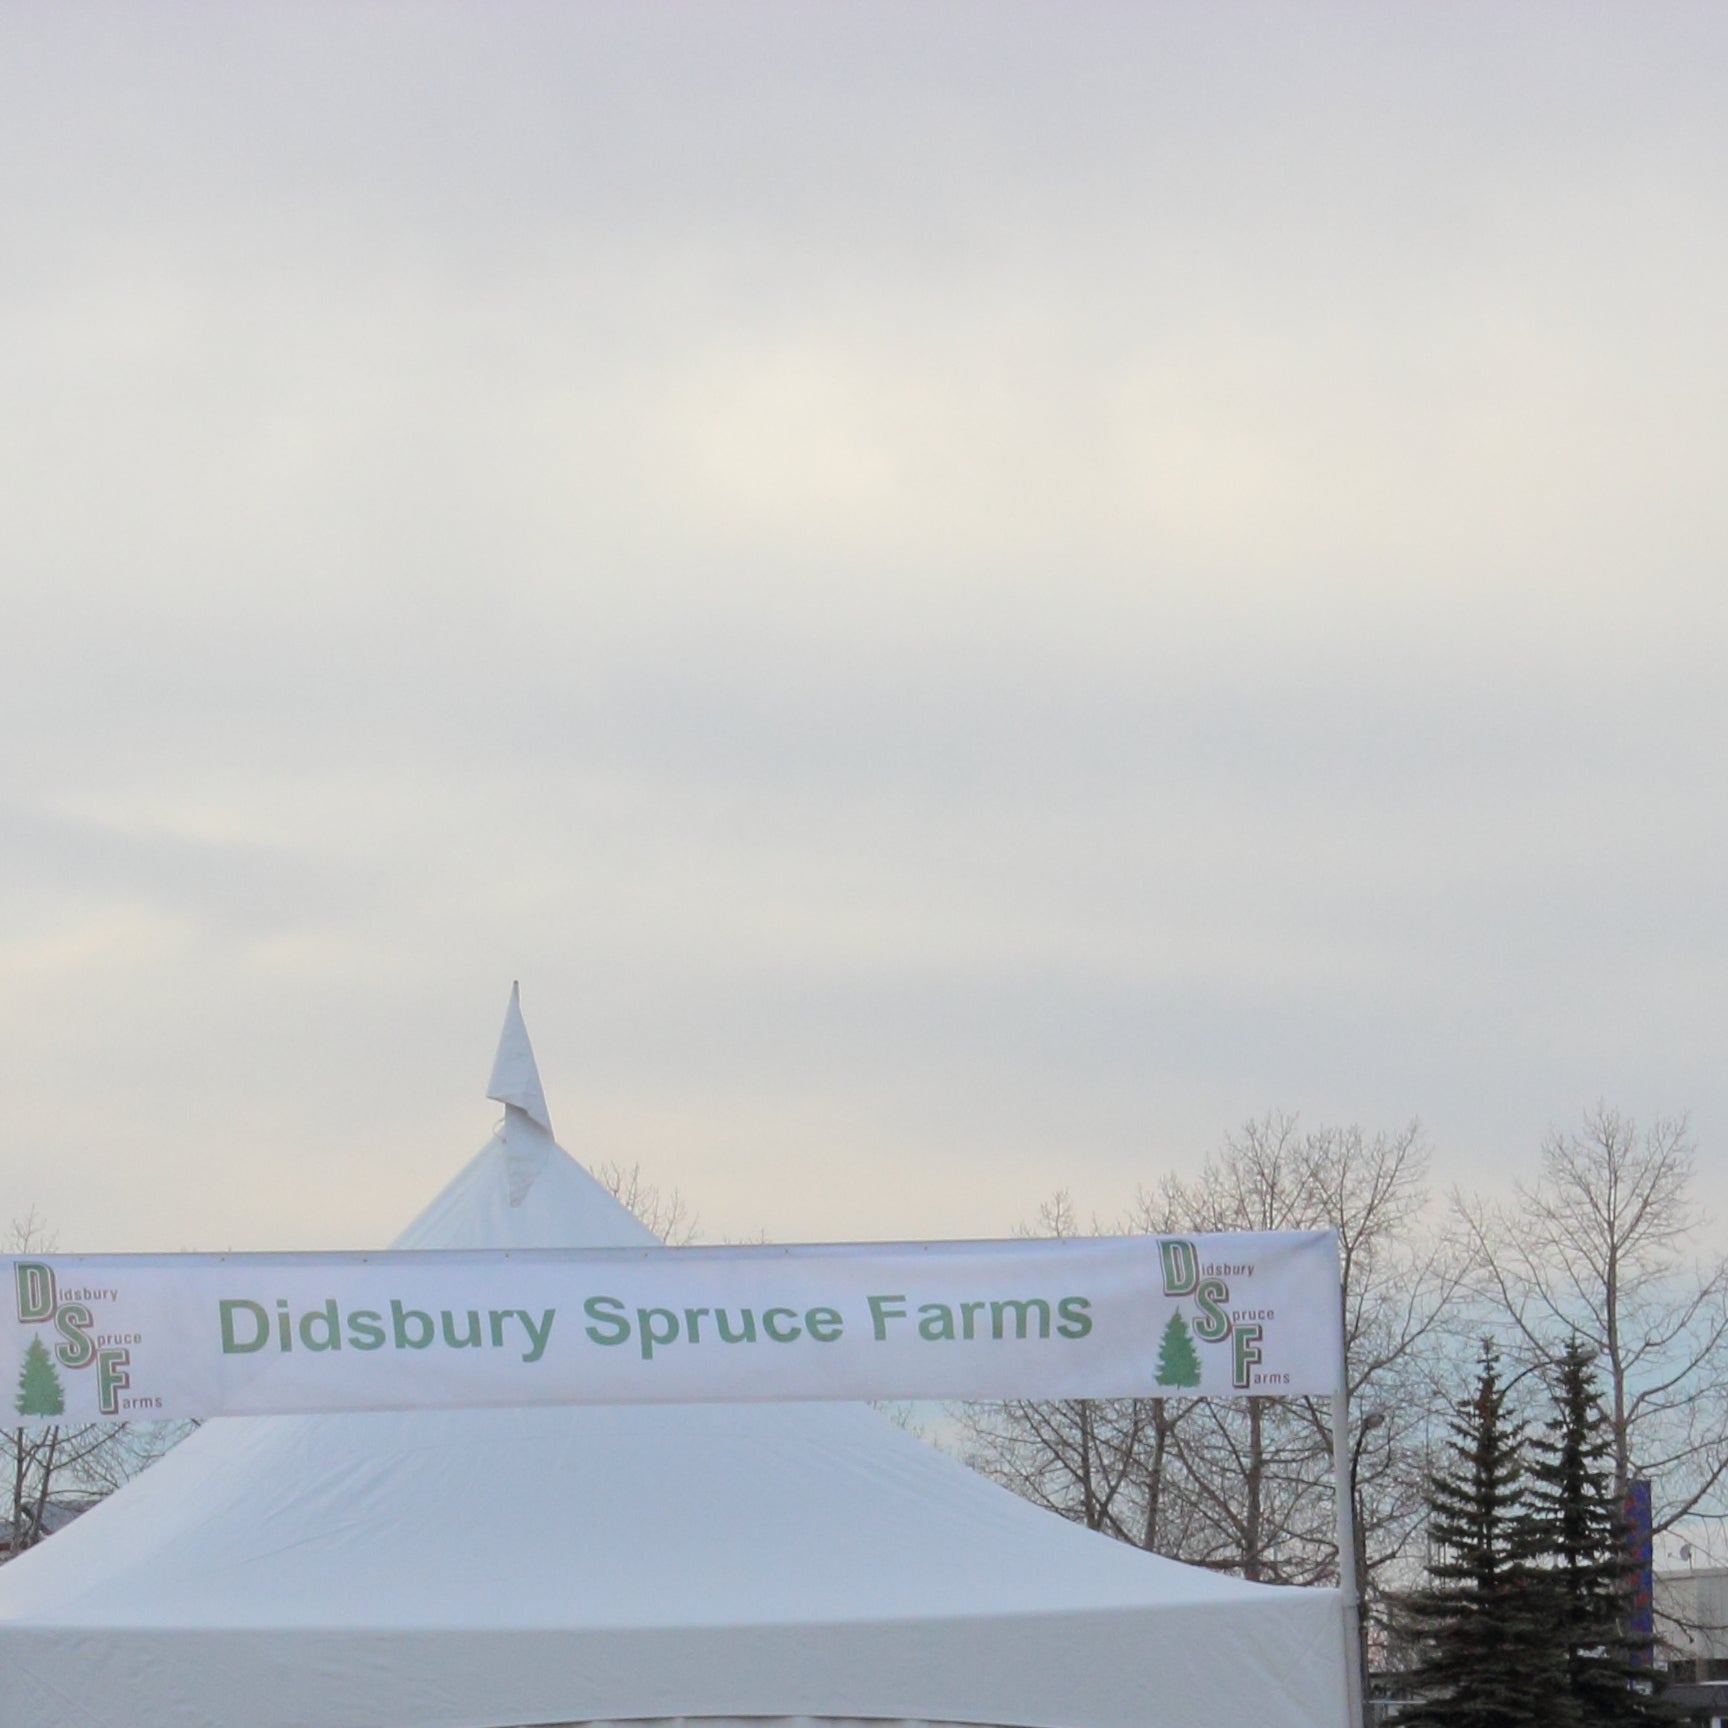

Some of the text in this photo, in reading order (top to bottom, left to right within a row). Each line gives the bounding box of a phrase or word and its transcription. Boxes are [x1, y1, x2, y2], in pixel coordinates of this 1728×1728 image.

[218, 1294, 1093, 1363] Didsbury Spruce Farms
